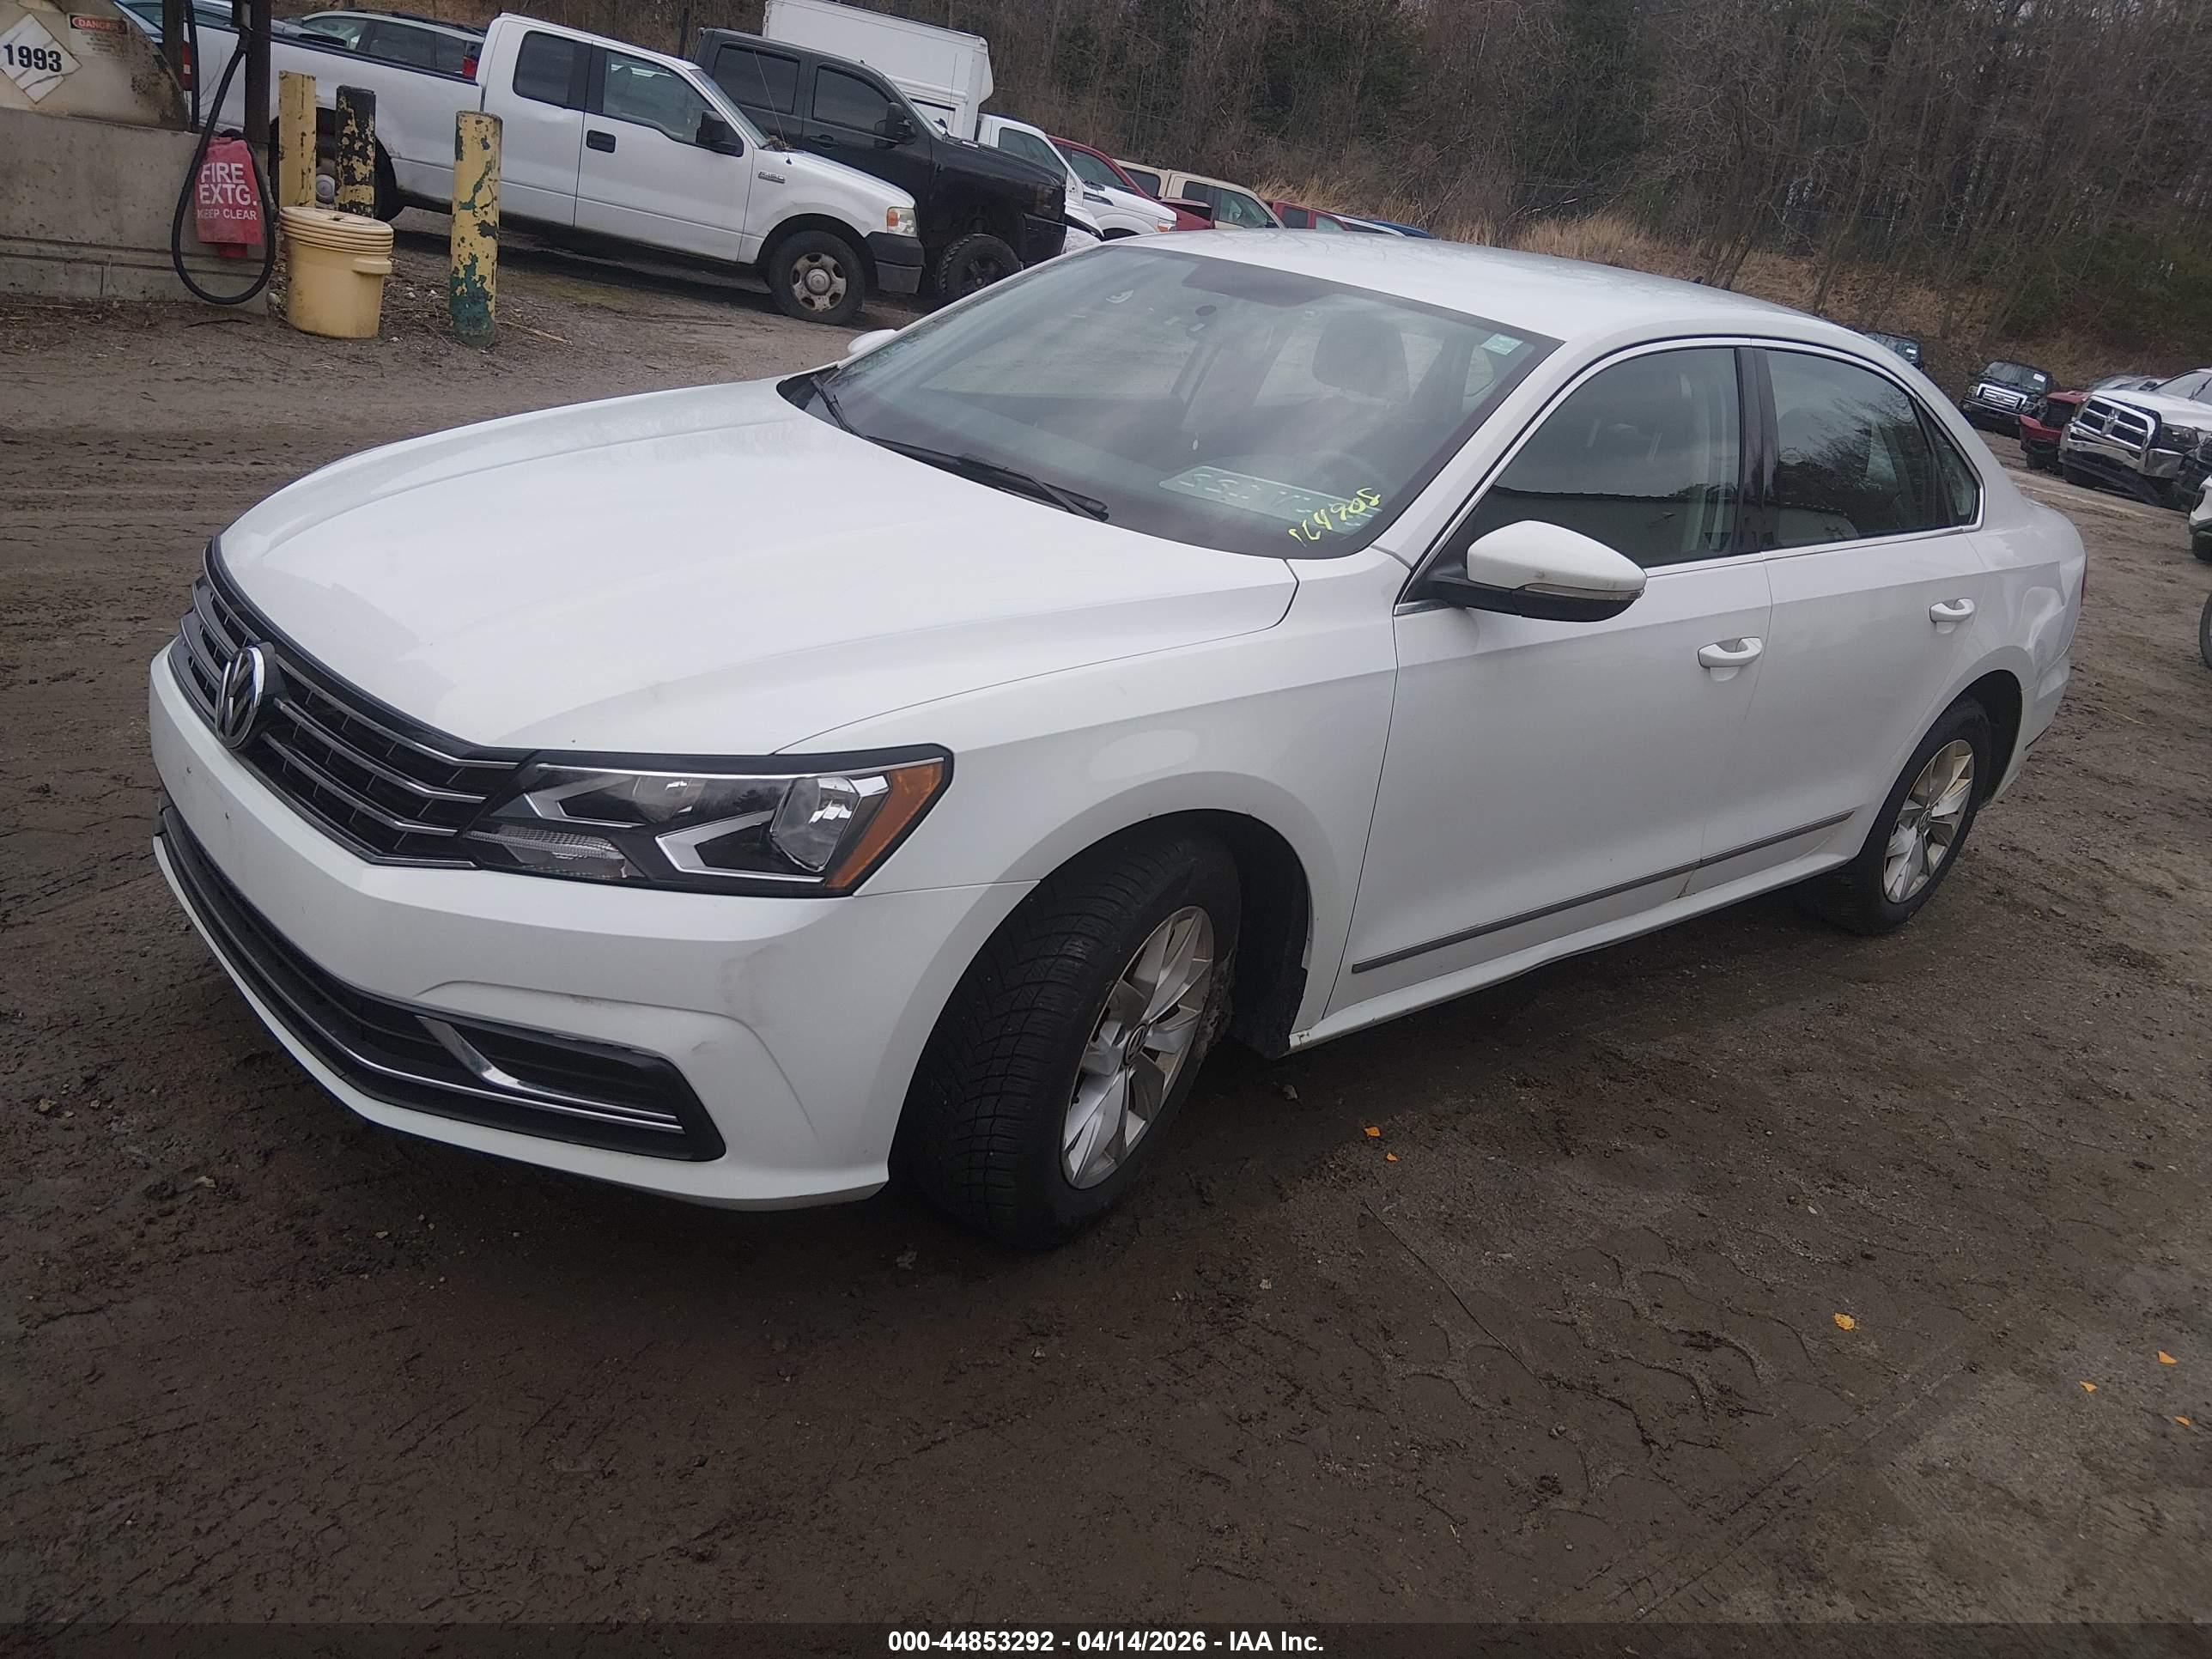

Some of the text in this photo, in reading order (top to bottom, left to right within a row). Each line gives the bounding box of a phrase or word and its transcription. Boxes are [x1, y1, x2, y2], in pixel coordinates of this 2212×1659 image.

[3, 44, 63, 73] 1993
[200, 162, 246, 184] FIRE
[199, 183, 258, 206] EXTG.
[197, 209, 257, 221] KEEP CLEAR
